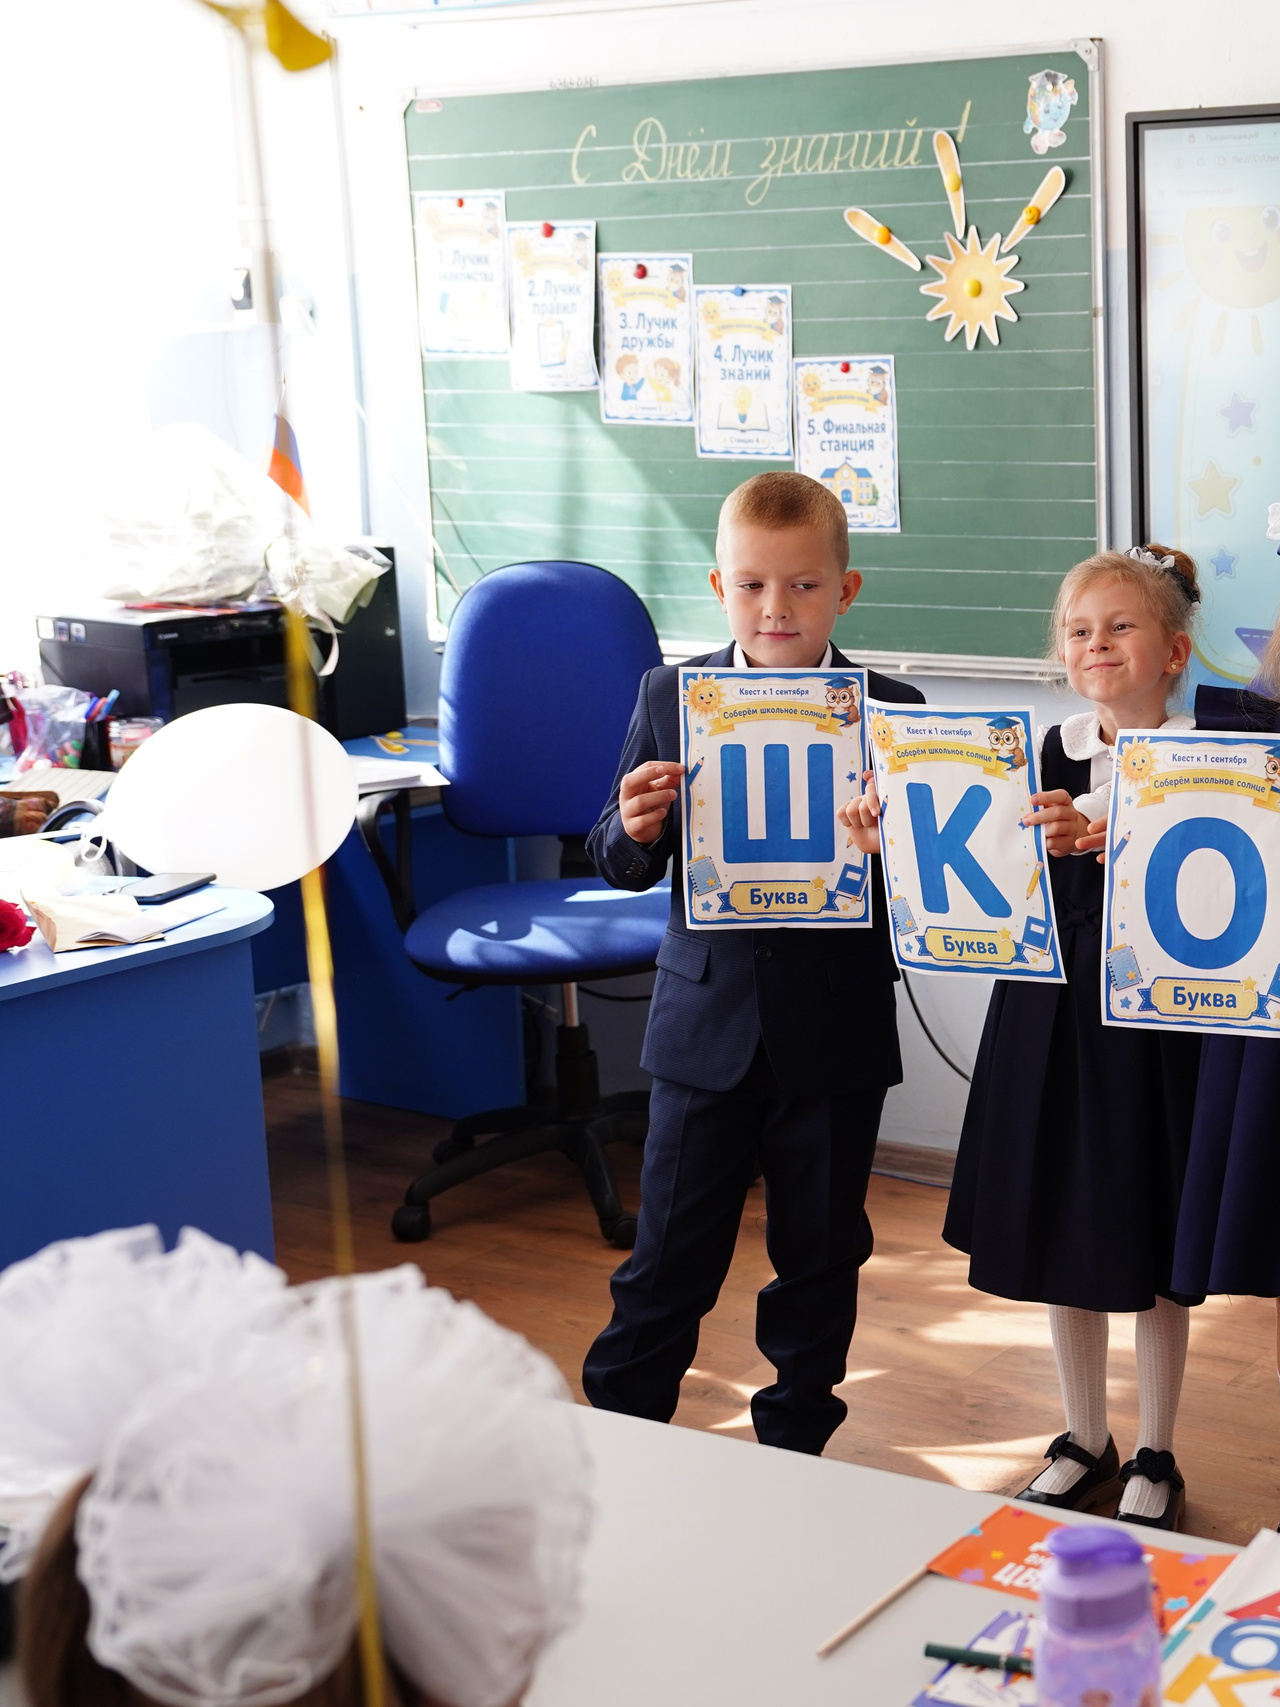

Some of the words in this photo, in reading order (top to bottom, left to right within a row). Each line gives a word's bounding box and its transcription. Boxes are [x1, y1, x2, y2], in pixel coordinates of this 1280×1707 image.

[622, 118, 733, 182] Днём
[452, 250, 490, 268] Лучик
[543, 280, 582, 300] Лучик
[532, 301, 577, 318] правил
[619, 312, 632, 330] 3.
[636, 312, 678, 332] Лучик
[622, 334, 675, 351] дружбы
[714, 345, 728, 362] 4.
[732, 345, 774, 367] Лучик
[720, 364, 772, 381] знаний
[807, 418, 820, 436] 5.
[823, 418, 886, 435] Финальная
[820, 438, 875, 453] станция
[739, 687, 761, 696] Квест
[769, 688, 773, 696] 1
[775, 688, 810, 698] сентября
[723, 706, 758, 722] Соберём
[760, 706, 799, 718] школьное
[801, 709, 827, 720] солнце
[906, 726, 927, 736] Квест
[935, 728, 938, 736] 1
[940, 728, 973, 738] сентября
[896, 746, 926, 761] Соберём
[928, 746, 964, 758] школьное
[966, 751, 992, 763] солнце
[1172, 753, 1194, 764] Квест
[1204, 754, 1208, 763] 1
[1210, 754, 1247, 766] сентября
[1154, 776, 1192, 790] Соберём
[1192, 776, 1234, 787] школьное
[1236, 780, 1266, 794] солнце
[720, 744, 835, 864] Ш
[906, 782, 1012, 918] К
[750, 888, 808, 908] Буква
[1144, 816, 1268, 970] О
[942, 936, 998, 956] Буква
[1173, 986, 1237, 1012] Буква
